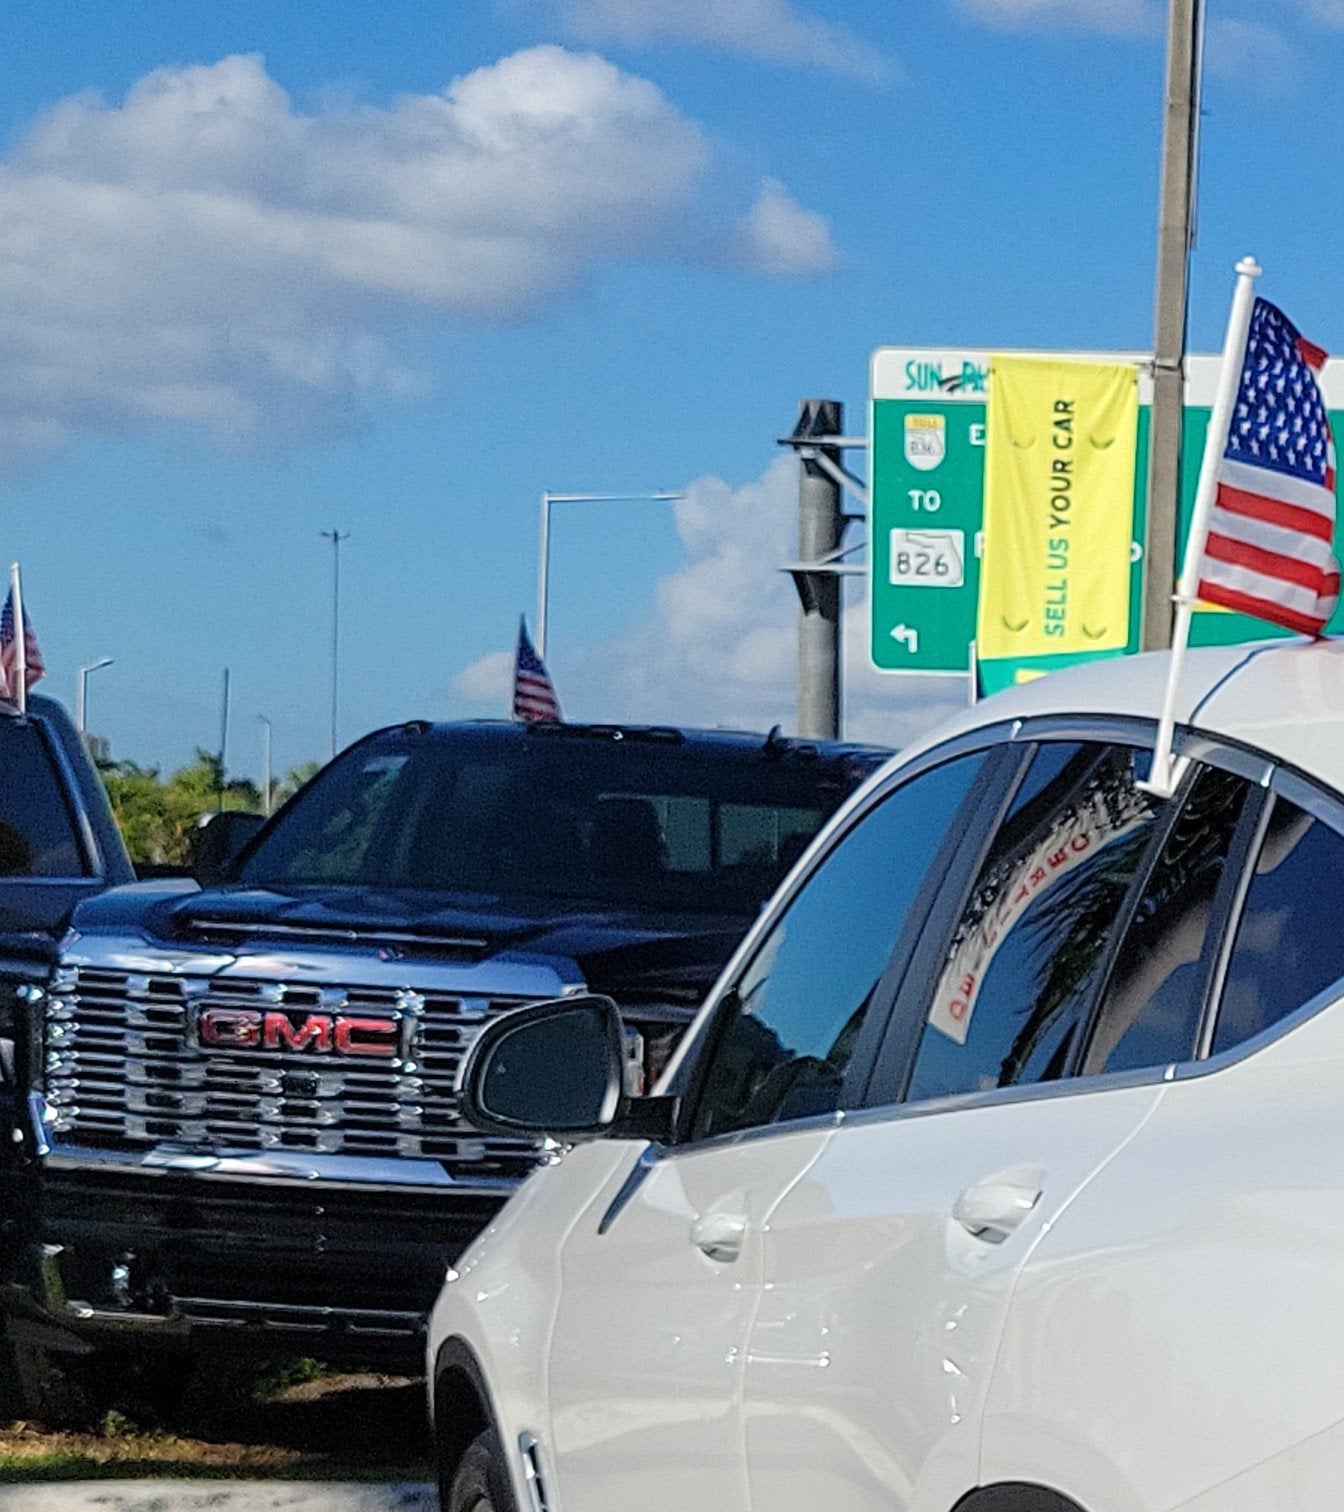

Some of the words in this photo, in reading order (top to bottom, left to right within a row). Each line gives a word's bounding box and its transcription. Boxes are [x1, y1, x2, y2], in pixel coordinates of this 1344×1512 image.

[903, 359, 942, 392] SUN
[1053, 400, 1075, 450] CAR
[907, 489, 942, 512] TO
[1049, 459, 1072, 529] YOUR
[897, 552, 950, 577] 826
[1047, 537, 1069, 570] US
[1045, 578, 1067, 638] SELL
[202, 1008, 398, 1056] GMC
